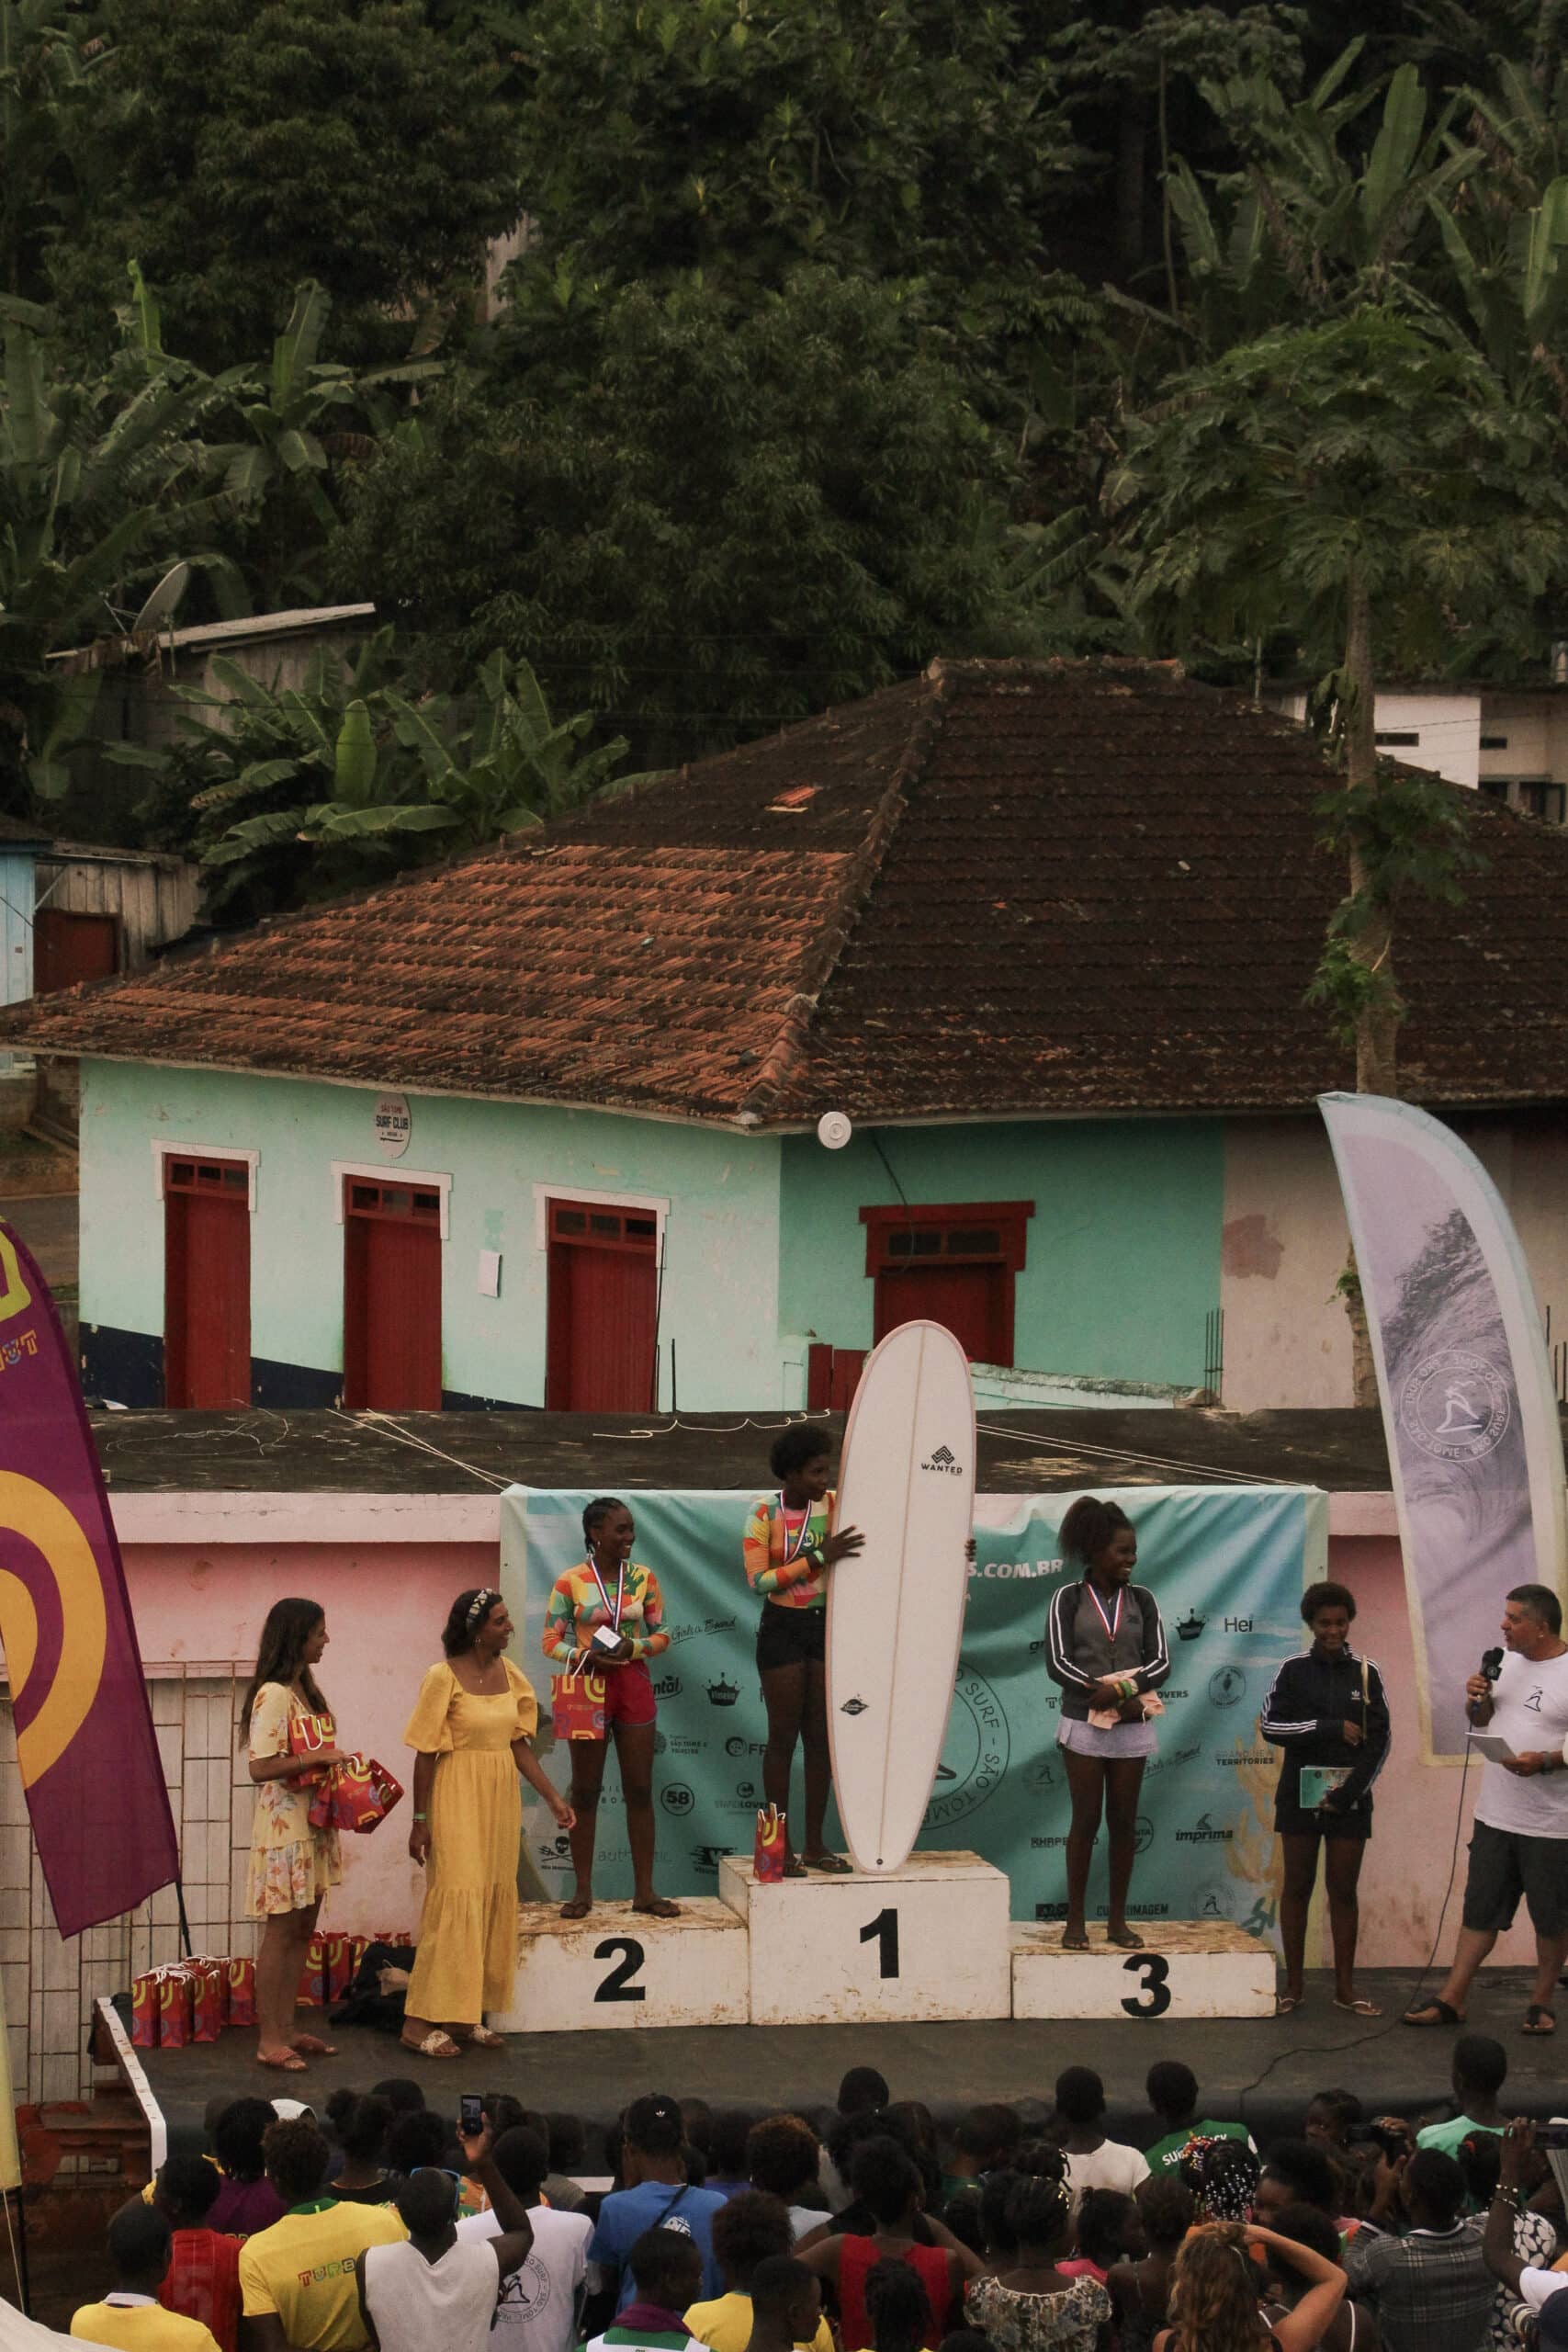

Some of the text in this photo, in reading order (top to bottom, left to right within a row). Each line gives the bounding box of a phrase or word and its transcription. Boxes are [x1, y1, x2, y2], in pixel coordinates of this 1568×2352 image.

[376, 1114, 409, 1130] SURF CLUB
[921, 1463, 963, 1474] WANTED
[1224, 1613, 1253, 1633] Hei
[965, 1682, 1000, 1728] SURF
[976, 1753, 1000, 1788] SÃO
[1215, 1757, 1275, 1766] TERRITORIES
[667, 1790, 690, 1805] 58
[1176, 1828, 1233, 1844] imprima
[860, 1908, 899, 1979] 1
[593, 1937, 646, 2002] 2
[1121, 1953, 1171, 2018] 3
